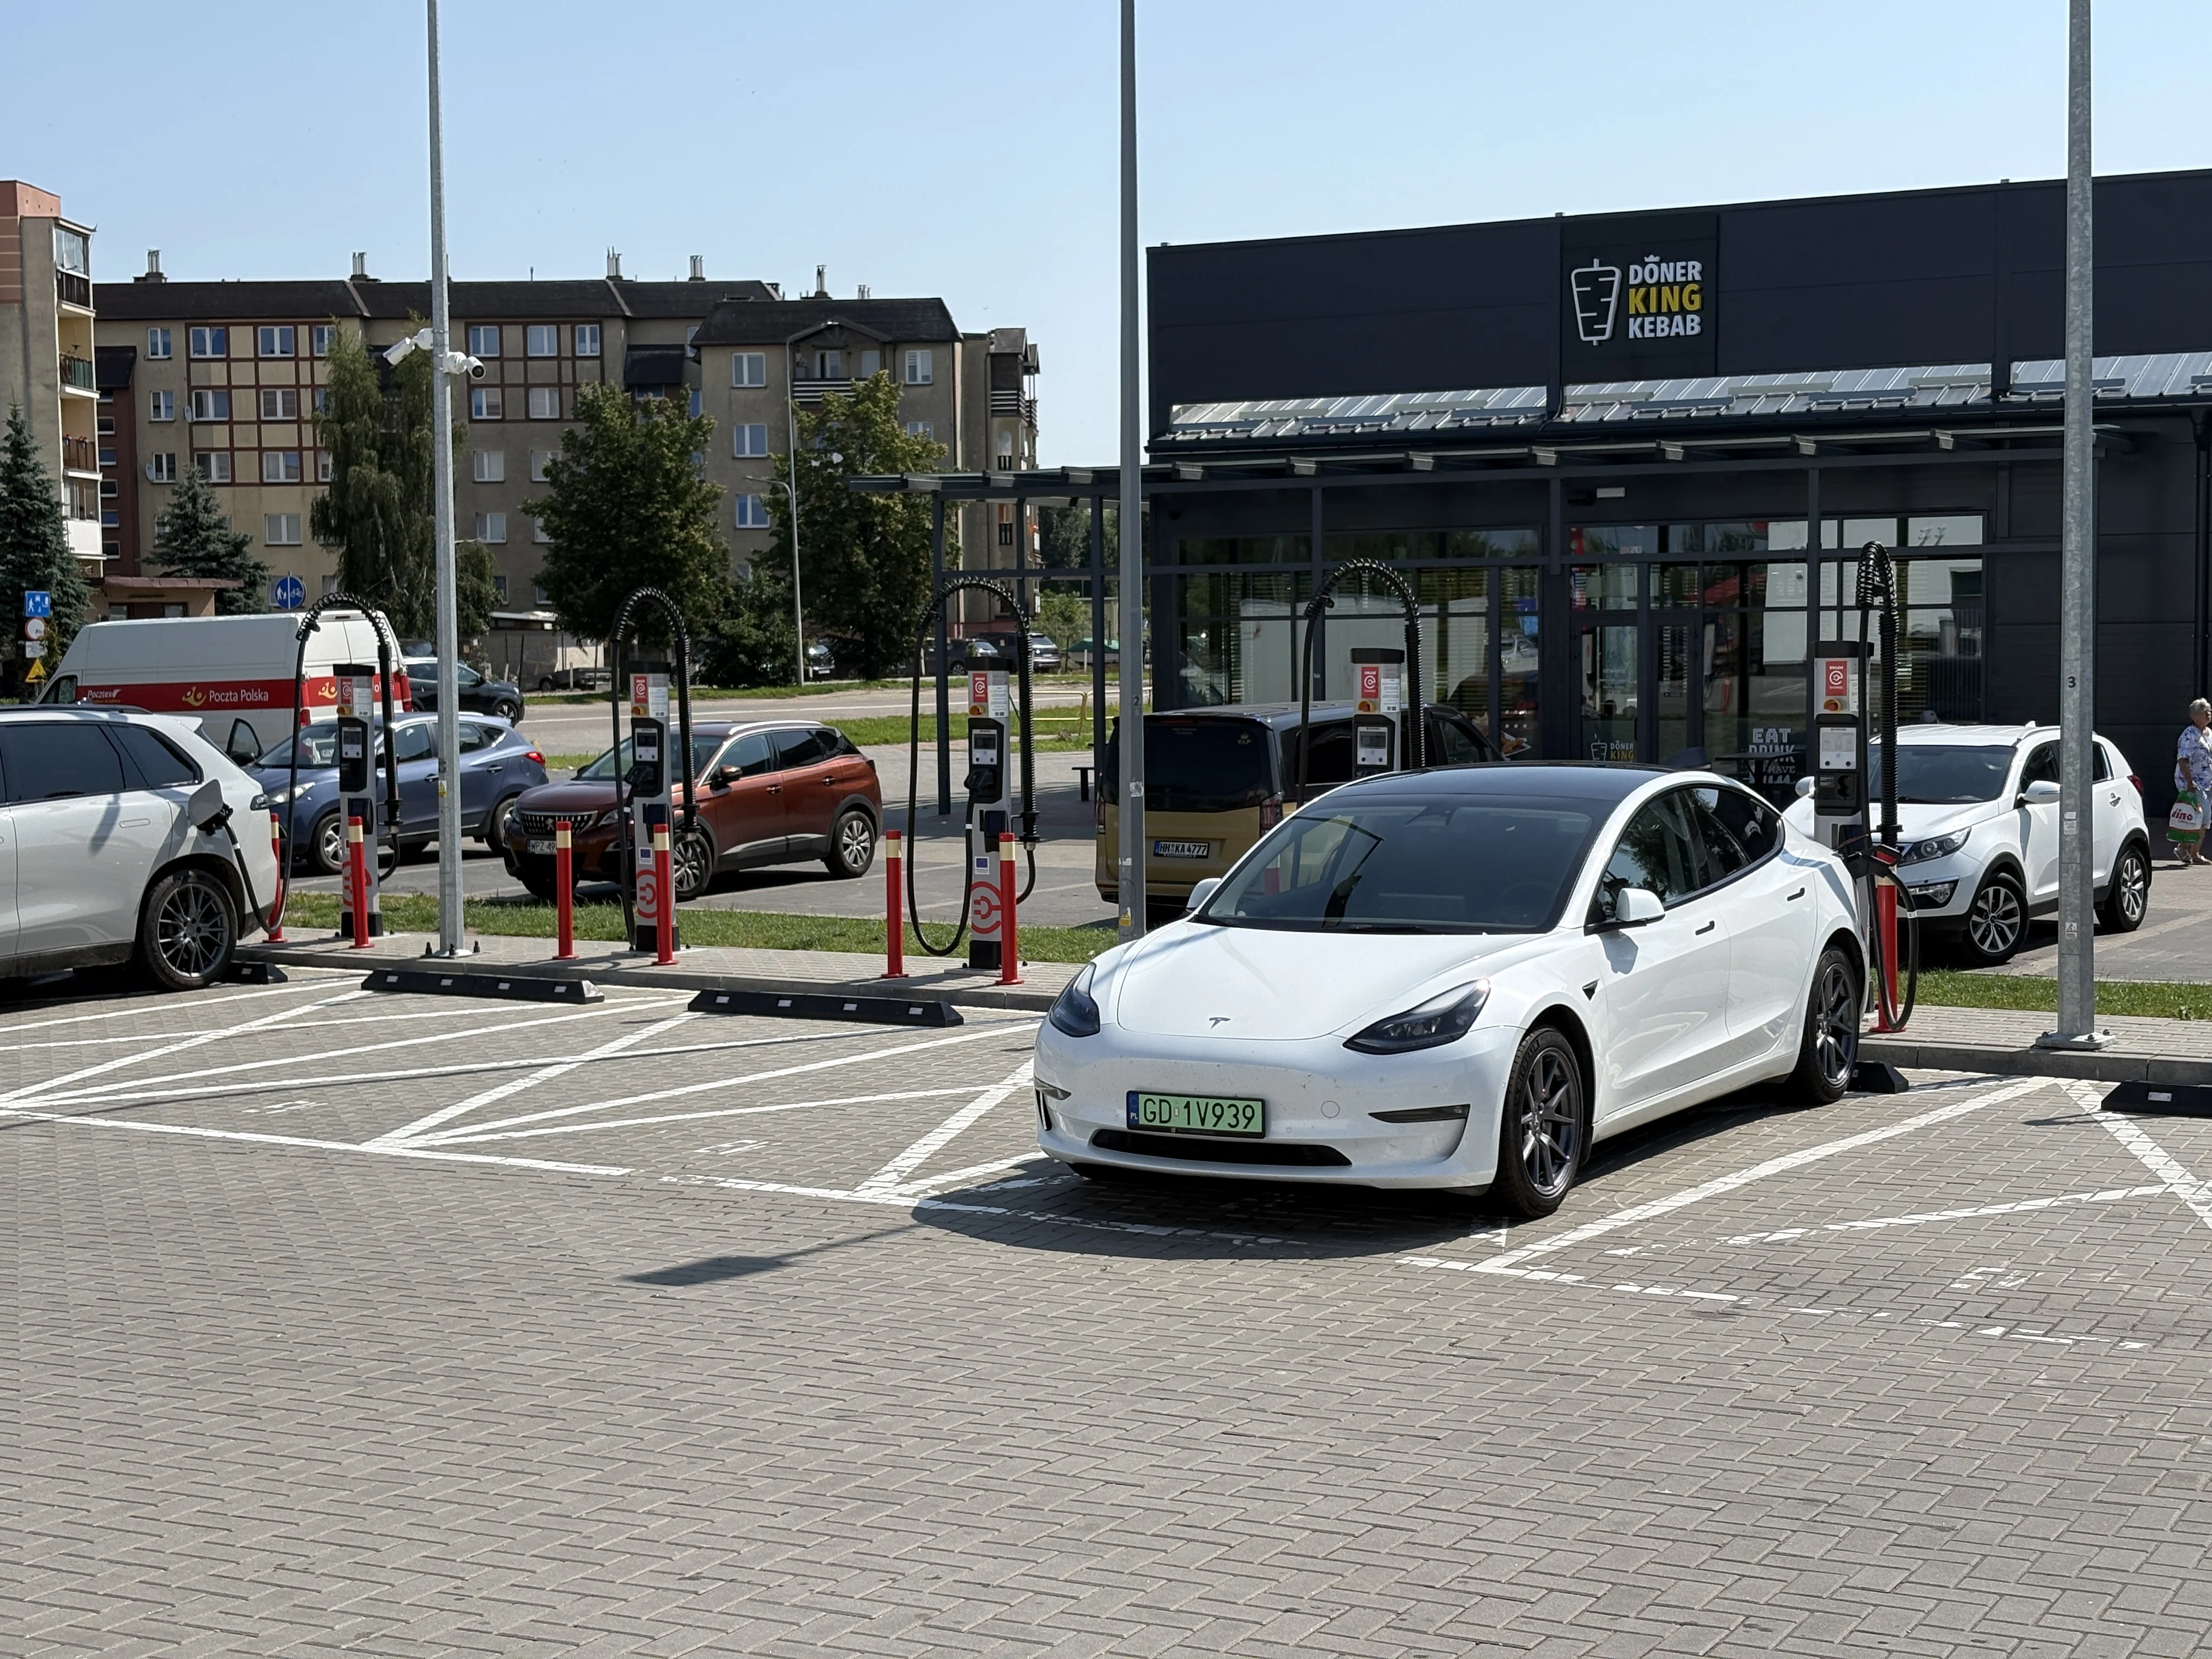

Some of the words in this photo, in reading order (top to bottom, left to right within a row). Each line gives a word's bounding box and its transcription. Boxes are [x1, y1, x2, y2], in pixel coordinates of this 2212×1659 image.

[1628, 283, 1701, 314] KING
[1628, 314, 1701, 339] KEBAB
[2068, 676, 2076, 689] 3
[87, 689, 112, 699] Pocztex
[209, 690, 238, 703] Poczta
[240, 688, 268, 702] Polska
[1133, 696, 1139, 707] 2
[1753, 727, 1791, 743] EAT
[1610, 750, 1634, 760] KING
[2171, 808, 2193, 821] dino
[546, 842, 556, 851] 49
[1160, 843, 1170, 853] HH
[1175, 844, 1185, 854] KA
[1187, 844, 1207, 855] 4777
[1130, 1112, 1138, 1120] PL
[1143, 1098, 1172, 1124] GD
[1183, 1101, 1255, 1130] 1V939
